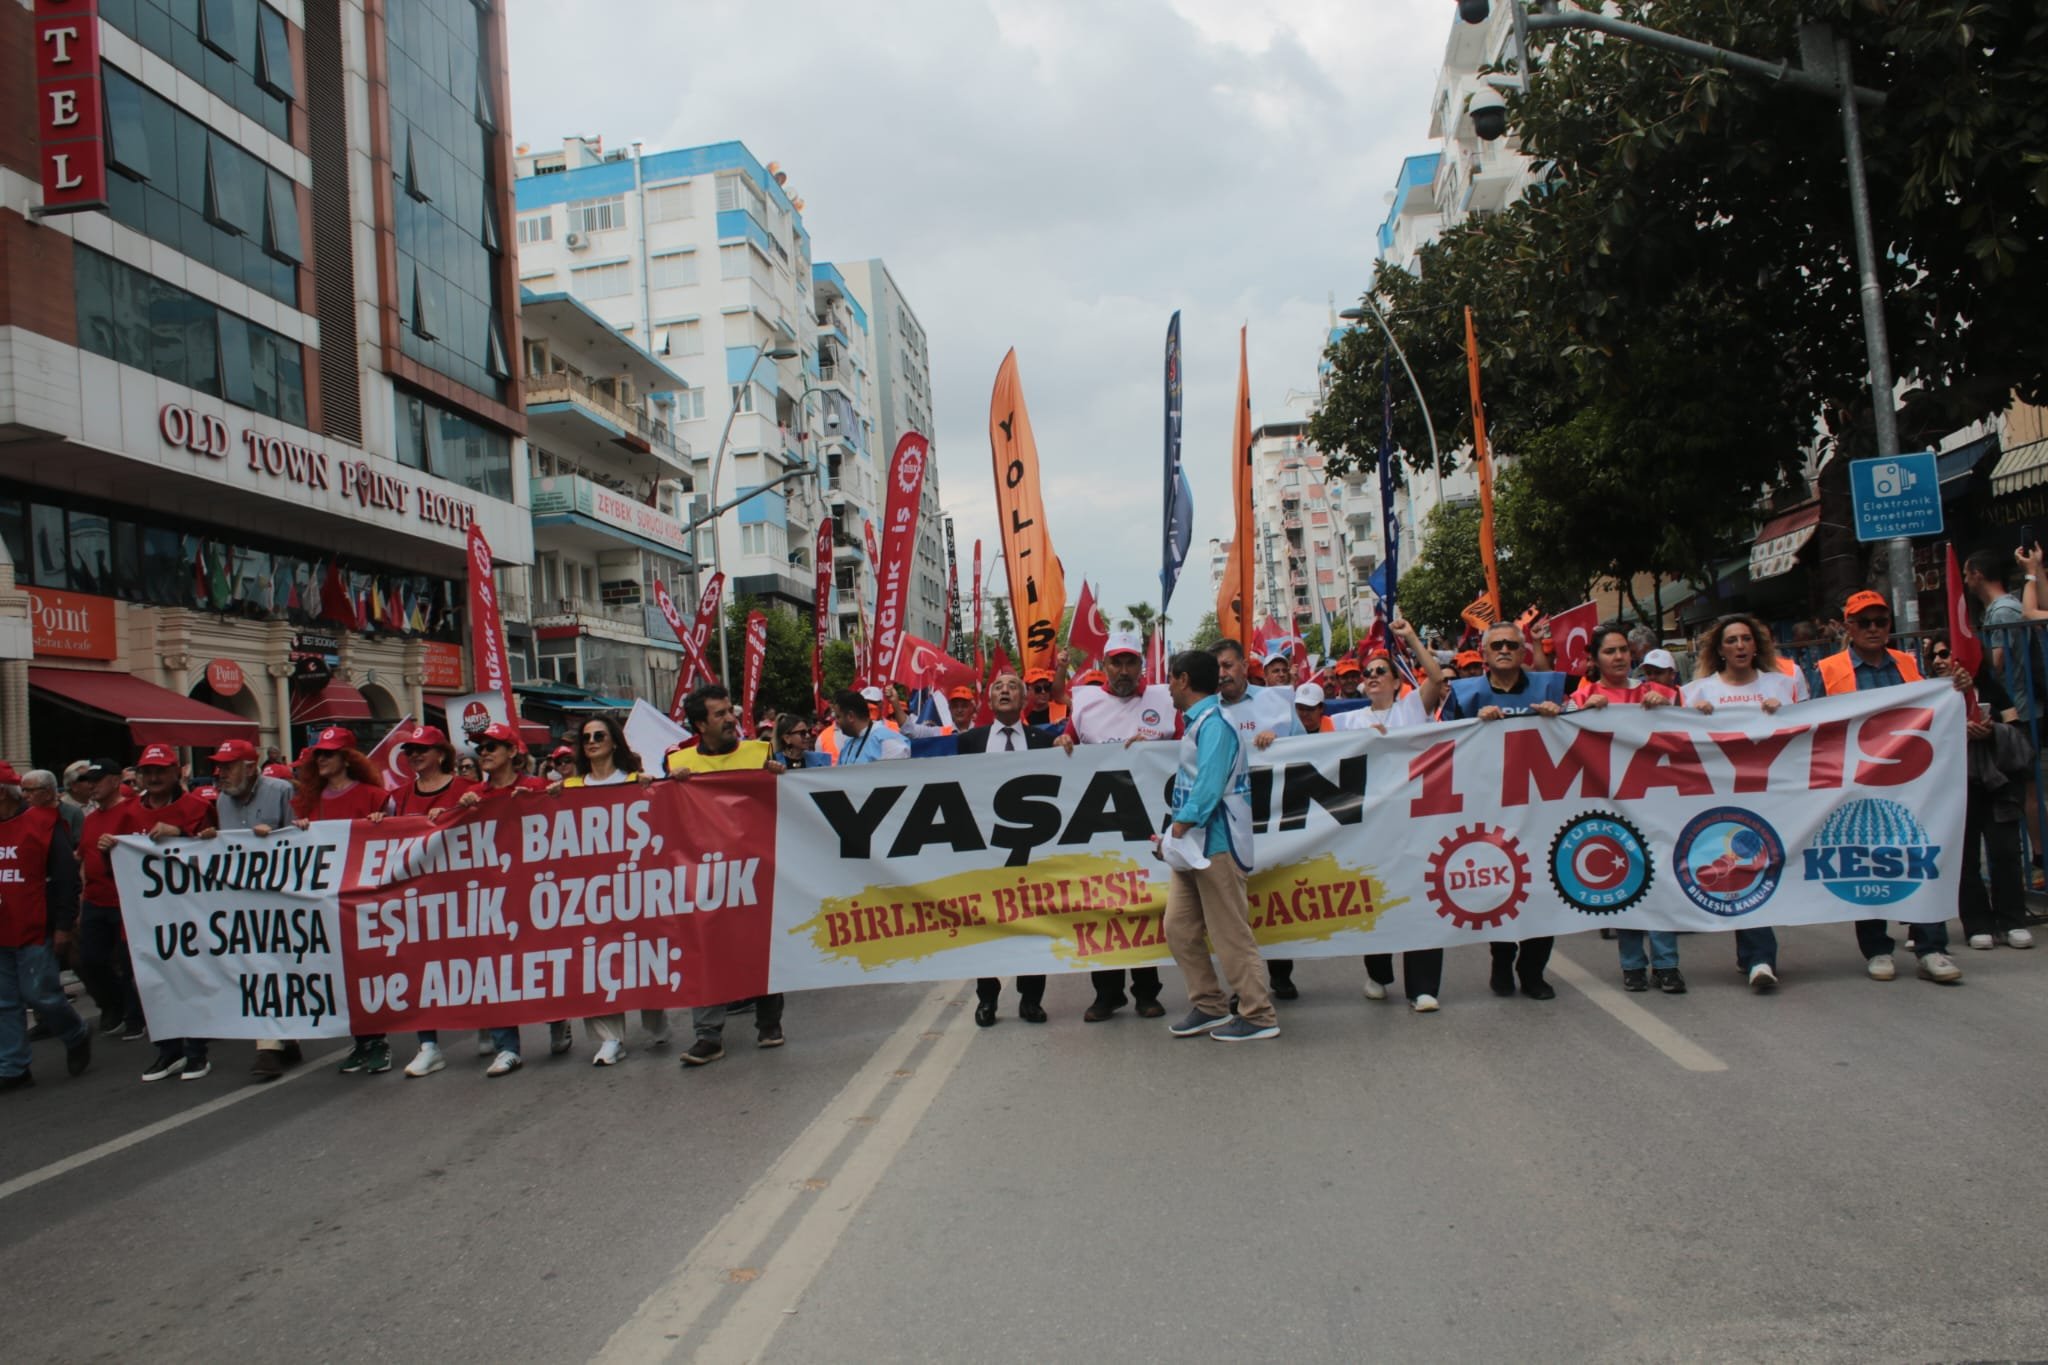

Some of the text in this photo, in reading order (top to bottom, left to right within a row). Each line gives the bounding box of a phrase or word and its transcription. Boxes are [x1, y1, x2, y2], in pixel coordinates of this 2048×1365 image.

[44, 0, 83, 189] TEL
[160, 403, 231, 460] OLD
[242, 428, 330, 491] TOWN
[597, 493, 633, 523] ZEYBEK
[1863, 496, 1932, 511] Elektronik
[1863, 508, 1934, 523] Denetleme
[1875, 520, 1925, 533] Sistemi
[878, 559, 902, 669] SAĞLIK
[891, 506, 911, 533] İŞ
[27, 595, 91, 636] Point
[955, 629, 965, 660] HOTE
[1408, 706, 1935, 818] 1 MAYIS
[809, 754, 1368, 867] YAŞAIN
[356, 800, 665, 888] EKMEK, BARIŞ,
[1562, 821, 1639, 853] TÜRK-İŞ
[141, 839, 336, 898] SÖMÜRÜYE
[1448, 858, 1511, 891] DİSK
[1803, 845, 1942, 881] KESK
[355, 851, 761, 957] EŞİTLİK, ÖZGÜRLÜK
[824, 868, 1153, 948] BİRLEŞE BİRLEŞE
[1577, 887, 1629, 905] 1952
[1687, 879, 1775, 913] BİRLEŞİK KAMU-İŞ
[1853, 884, 1891, 898] 1995
[154, 908, 331, 964] ve SAVAŞA
[358, 931, 683, 1014] ve ADALET İÇİN;
[239, 972, 337, 1027] KARŞI
